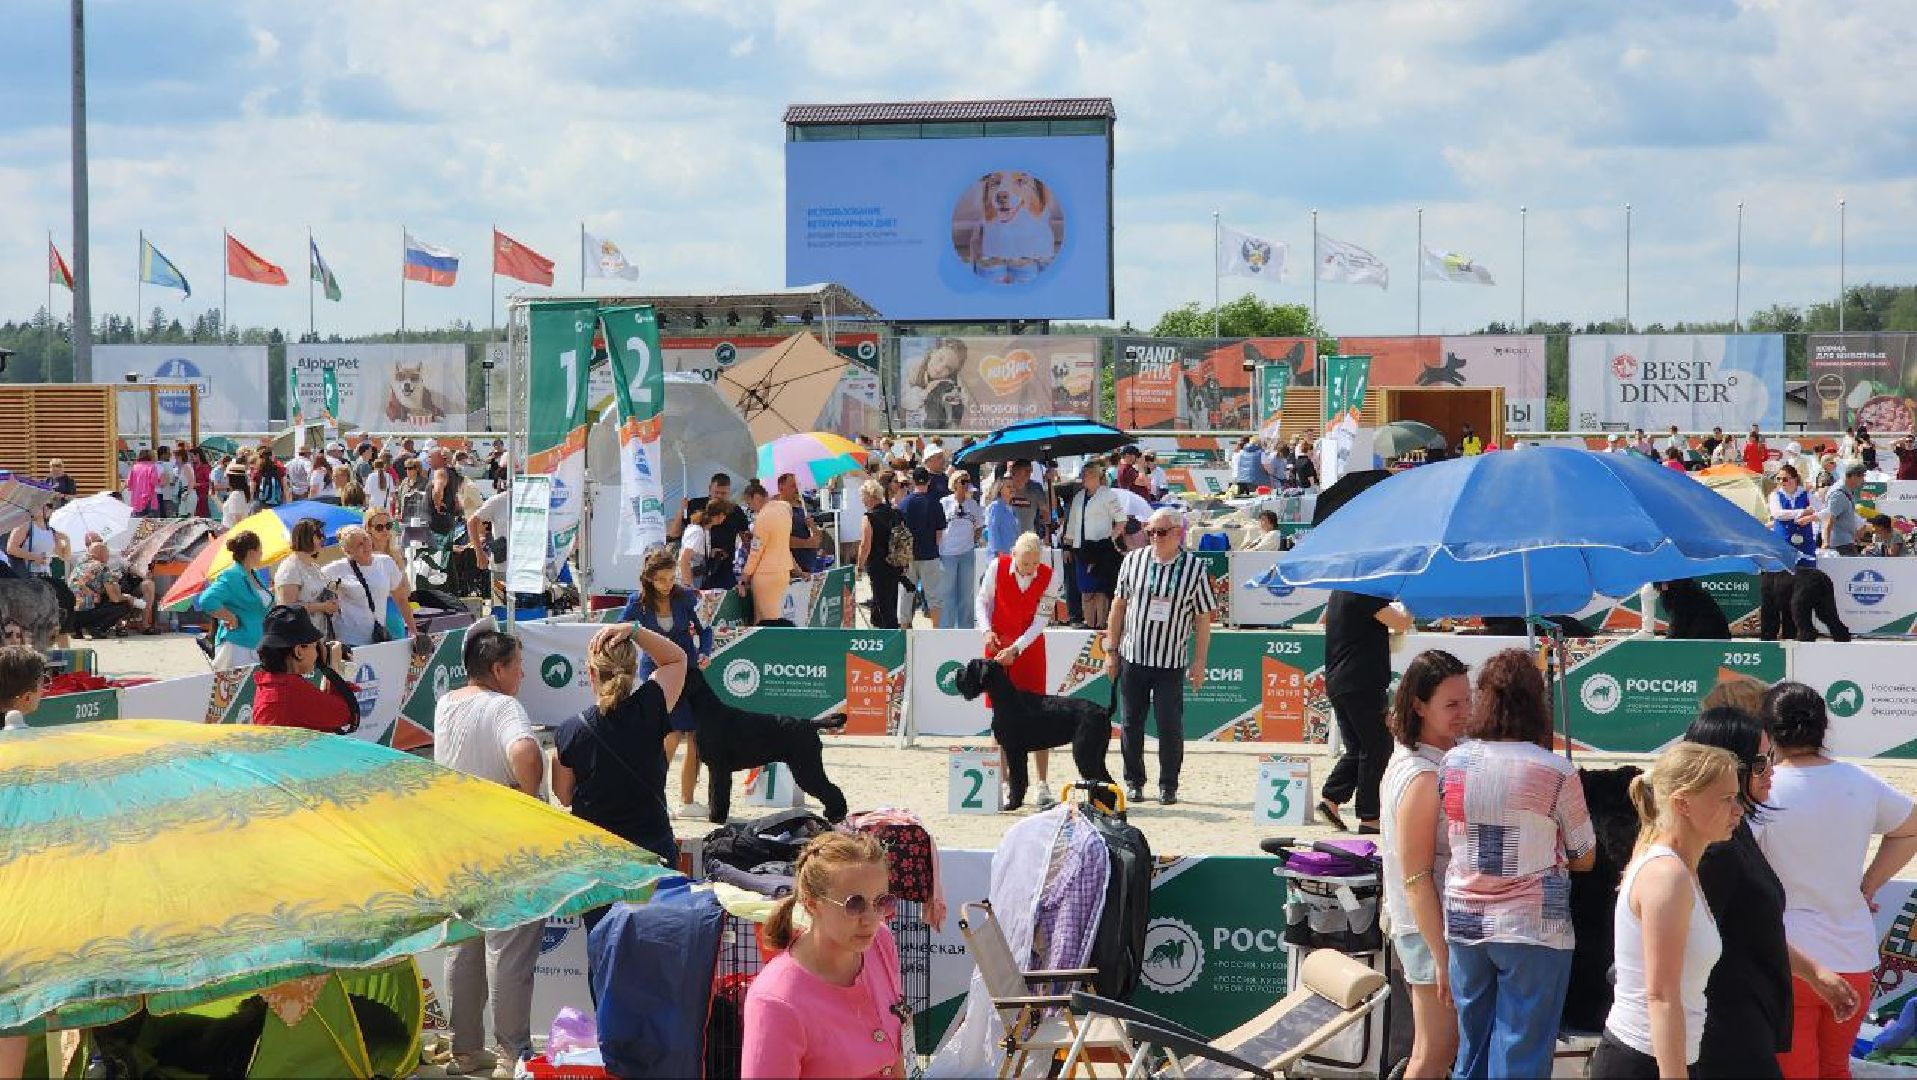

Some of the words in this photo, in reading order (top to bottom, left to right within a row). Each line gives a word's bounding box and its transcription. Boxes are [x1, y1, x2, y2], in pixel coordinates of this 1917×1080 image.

[626, 336, 651, 403] 2
[1640, 361, 1712, 381] BEST
[560, 350, 577, 419] 1
[1619, 383, 1732, 403] DINNER
[1701, 581, 1750, 591] РОССИЯ
[849, 639, 884, 651] 2025
[1266, 641, 1302, 654] 2025
[1724, 652, 1762, 665] 2025
[762, 662, 828, 678] РОССИЯ
[1625, 678, 1698, 694] РОССИЯ
[75, 701, 99, 720] 2025
[961, 768, 984, 809] 2
[1267, 778, 1291, 820] 3
